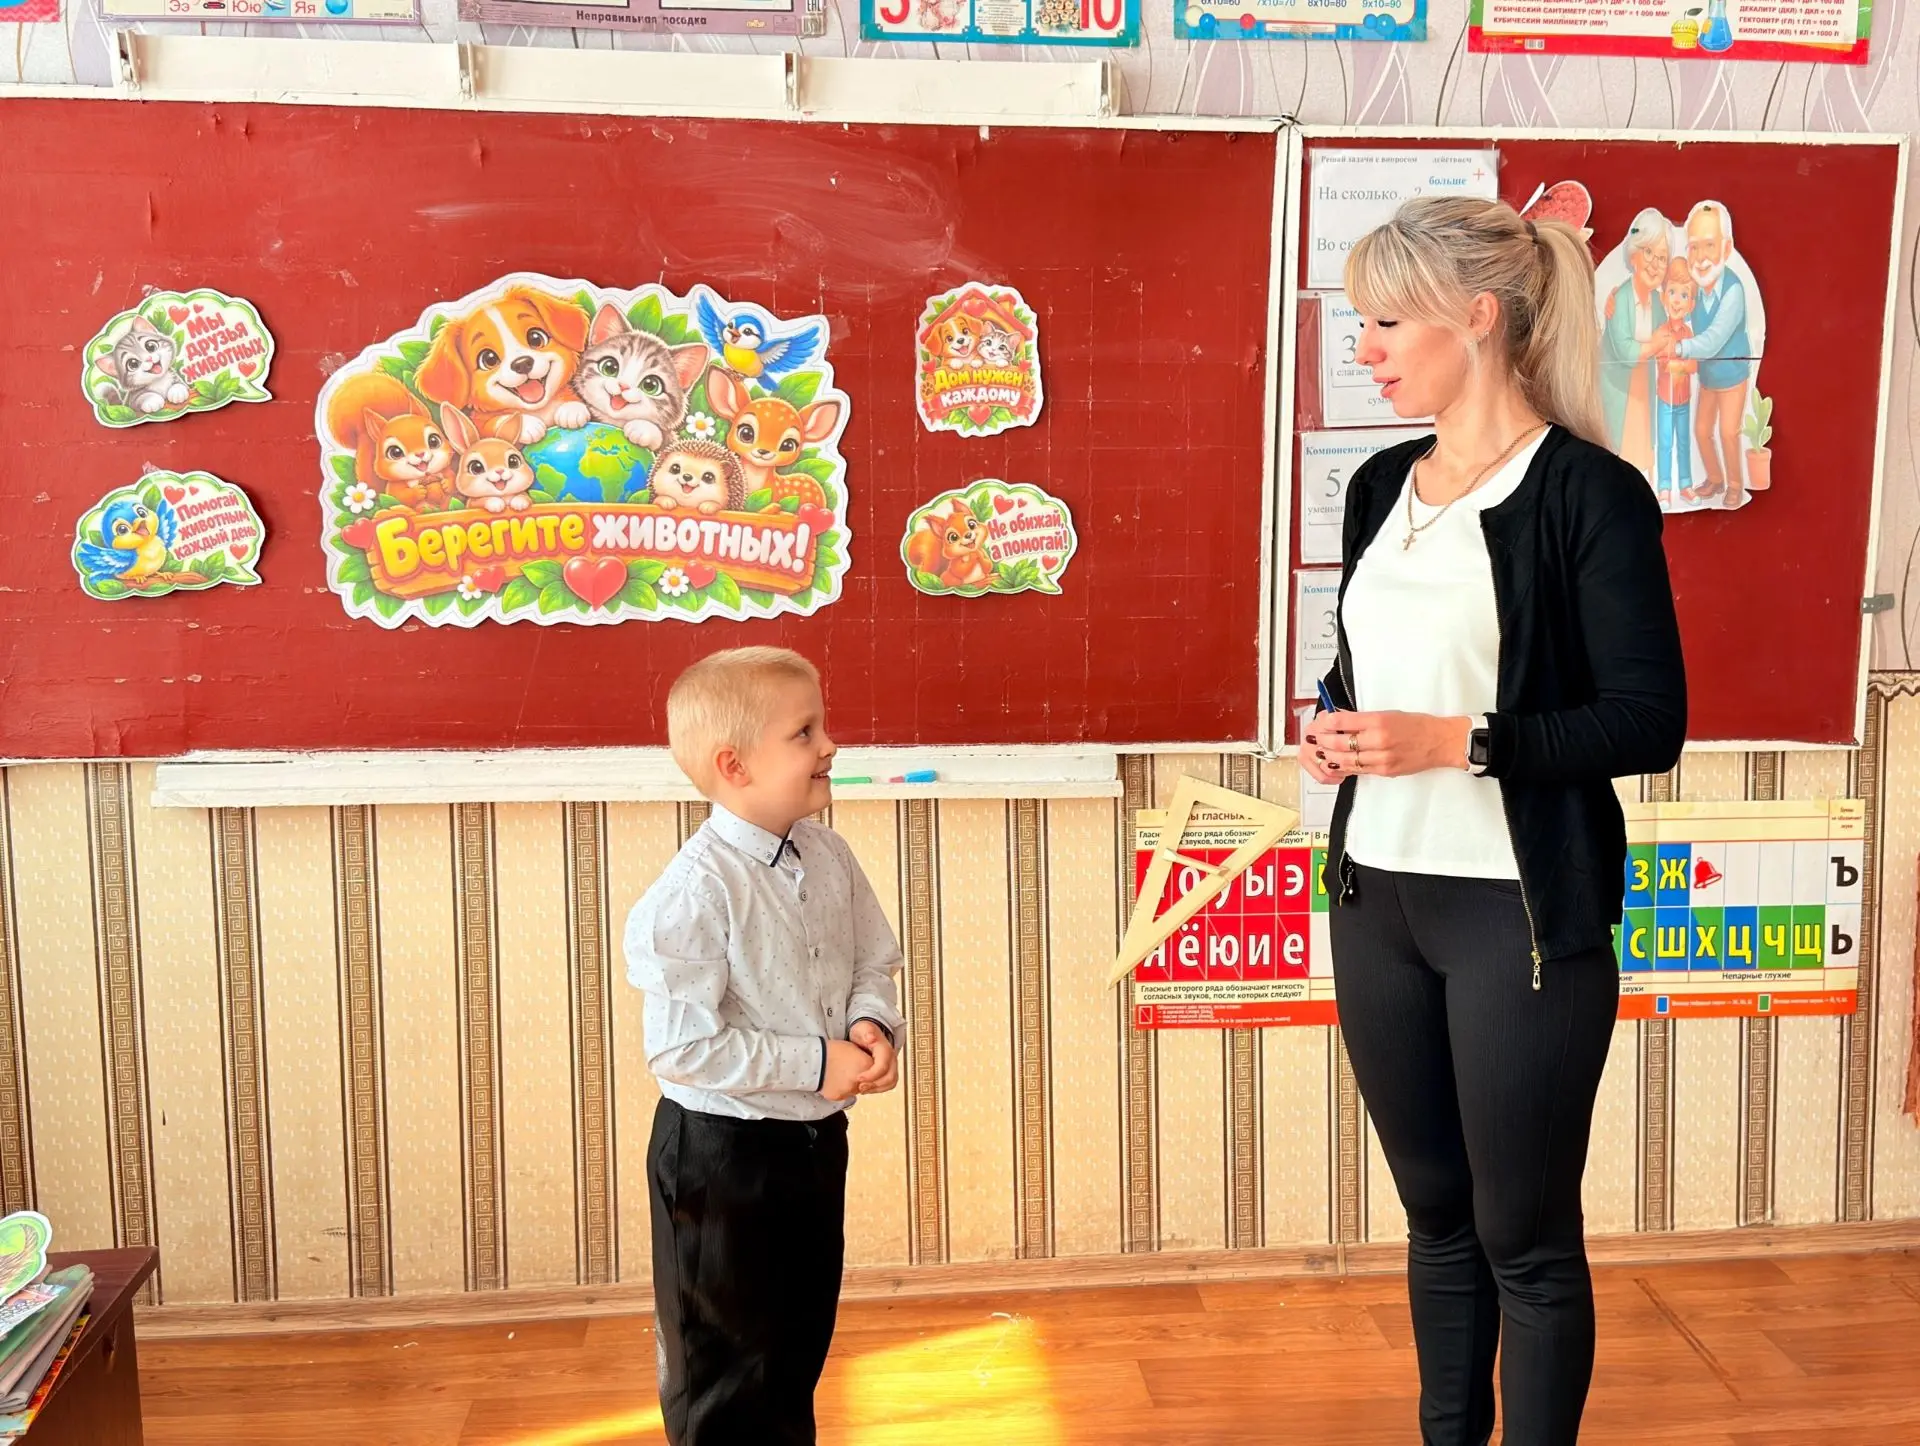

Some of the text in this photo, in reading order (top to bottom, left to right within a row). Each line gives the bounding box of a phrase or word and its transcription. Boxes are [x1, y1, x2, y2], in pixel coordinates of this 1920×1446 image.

[232, 0, 262, 13] Юю
[294, 1, 316, 14] Яя
[1543, 7, 1587, 15] САНТИМЕТР
[576, 9, 657, 25] Неправильная
[662, 15, 707, 27] посадка
[1493, 17, 1541, 25] КУБИЧЕСКИЙ
[1542, 18, 1588, 26] МИЛЛИМЕТР
[1739, 16, 1780, 24] ГЕКТОЛИТР
[1428, 175, 1468, 187] больше
[1319, 187, 1338, 201] На
[1317, 237, 1336, 252] Во
[186, 312, 226, 339] Мы
[1342, 334, 1357, 365] 3
[182, 336, 267, 382] животных
[934, 368, 1025, 393] Дом нужен
[1336, 368, 1373, 377] слагаем
[940, 386, 1021, 407] каждому
[1305, 446, 1367, 456] Компоненты
[1325, 468, 1342, 498] 5
[176, 491, 240, 523] Помогай
[178, 509, 250, 542] животным
[987, 509, 1065, 541] Не обижай,
[174, 526, 258, 561] каждый день
[374, 511, 811, 579] Берегите животных!
[990, 529, 1069, 561] а помогай!
[1321, 609, 1338, 639] 3
[1186, 839, 1213, 847] звуков,
[1214, 838, 1237, 846] после
[1204, 831, 1223, 839] ряда
[1245, 864, 1274, 897] ы
[1178, 922, 1201, 968] ё
[1209, 933, 1241, 968] ю
[1248, 933, 1271, 967] и
[1283, 932, 1305, 966] е
[1722, 971, 1792, 980] Непарные глухие
[1141, 983, 1305, 994] Гласные второго ряда обозначают мягкость
[1143, 990, 1302, 1001] согласных звуков, после которых следуют
[1622, 985, 1645, 994] звуки
